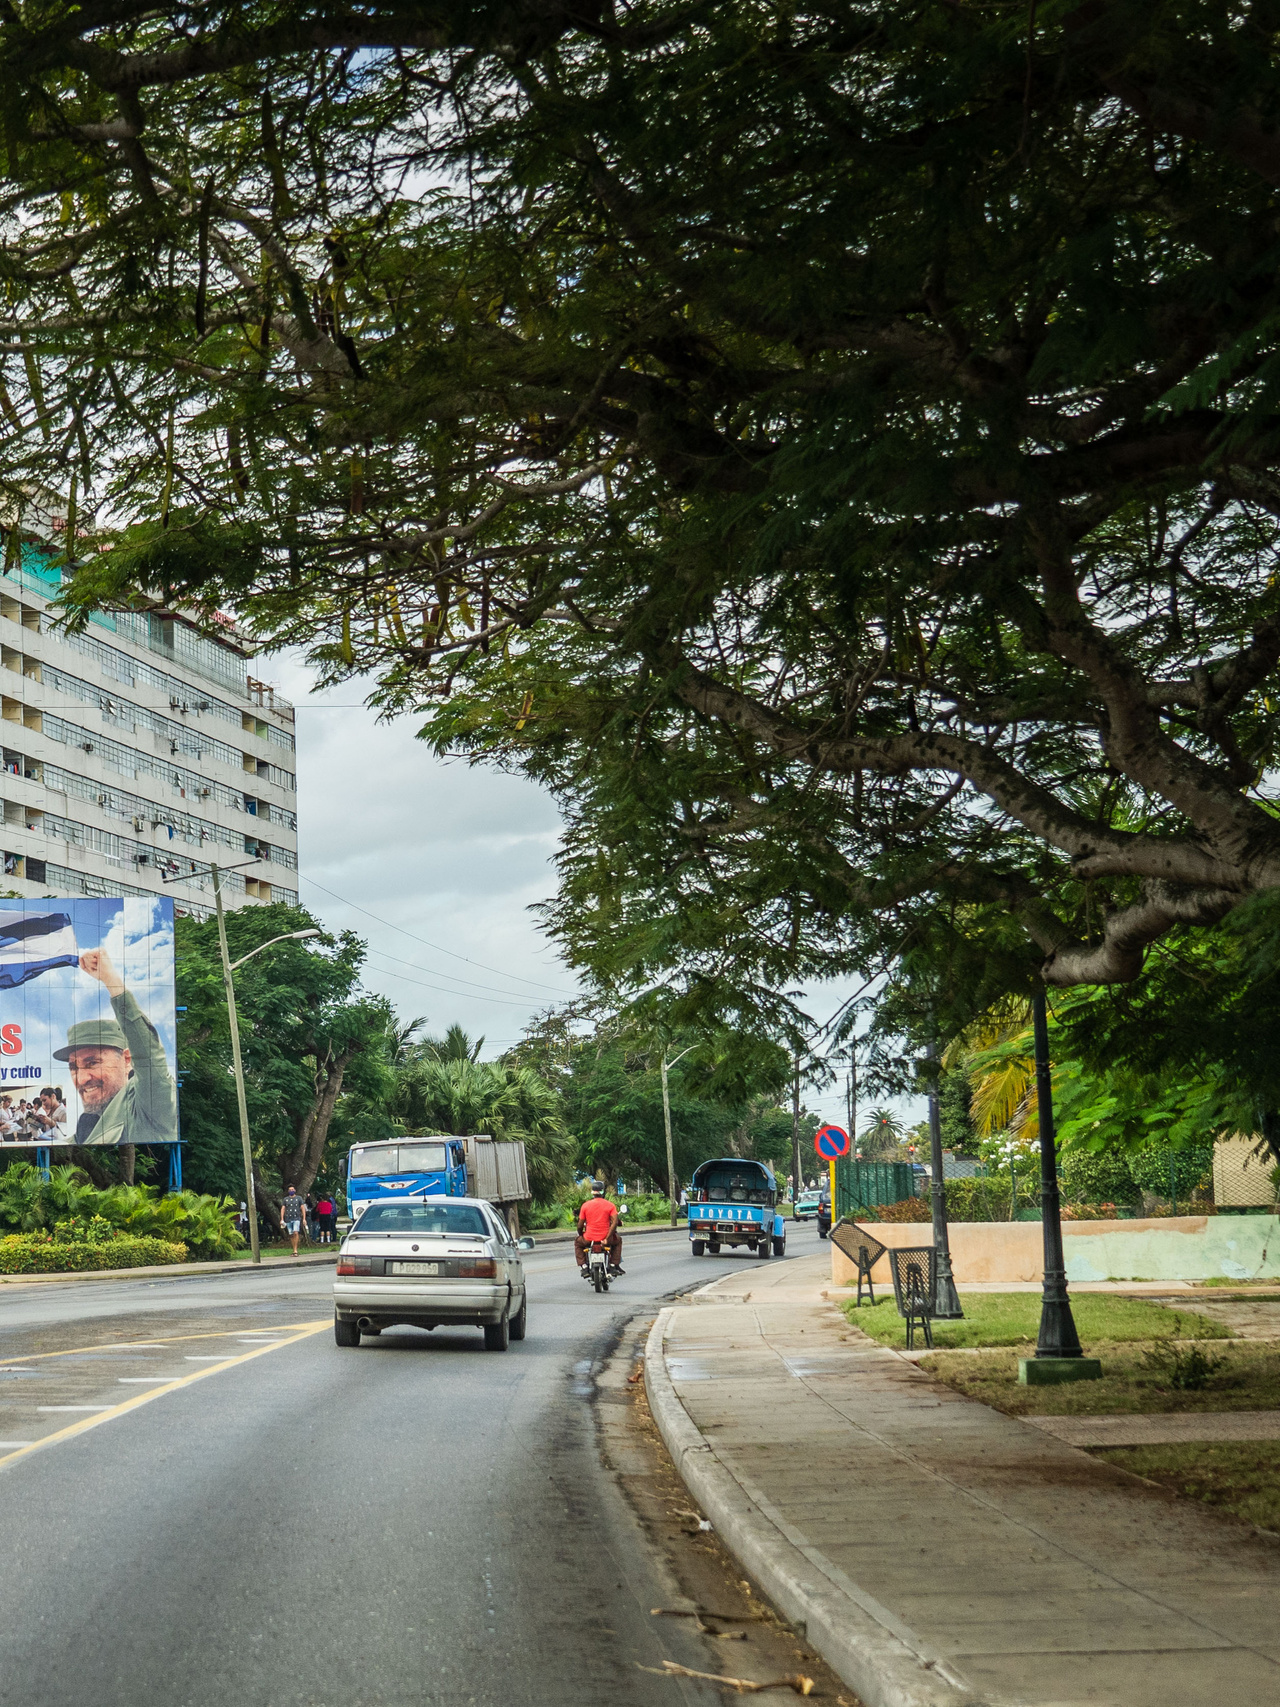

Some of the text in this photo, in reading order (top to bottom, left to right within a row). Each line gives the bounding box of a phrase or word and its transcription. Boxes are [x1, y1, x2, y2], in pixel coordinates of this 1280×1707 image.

[0, 1067, 8, 1080] y
[10, 1065, 42, 1079] culto
[699, 1208, 753, 1220] TOYOTA
